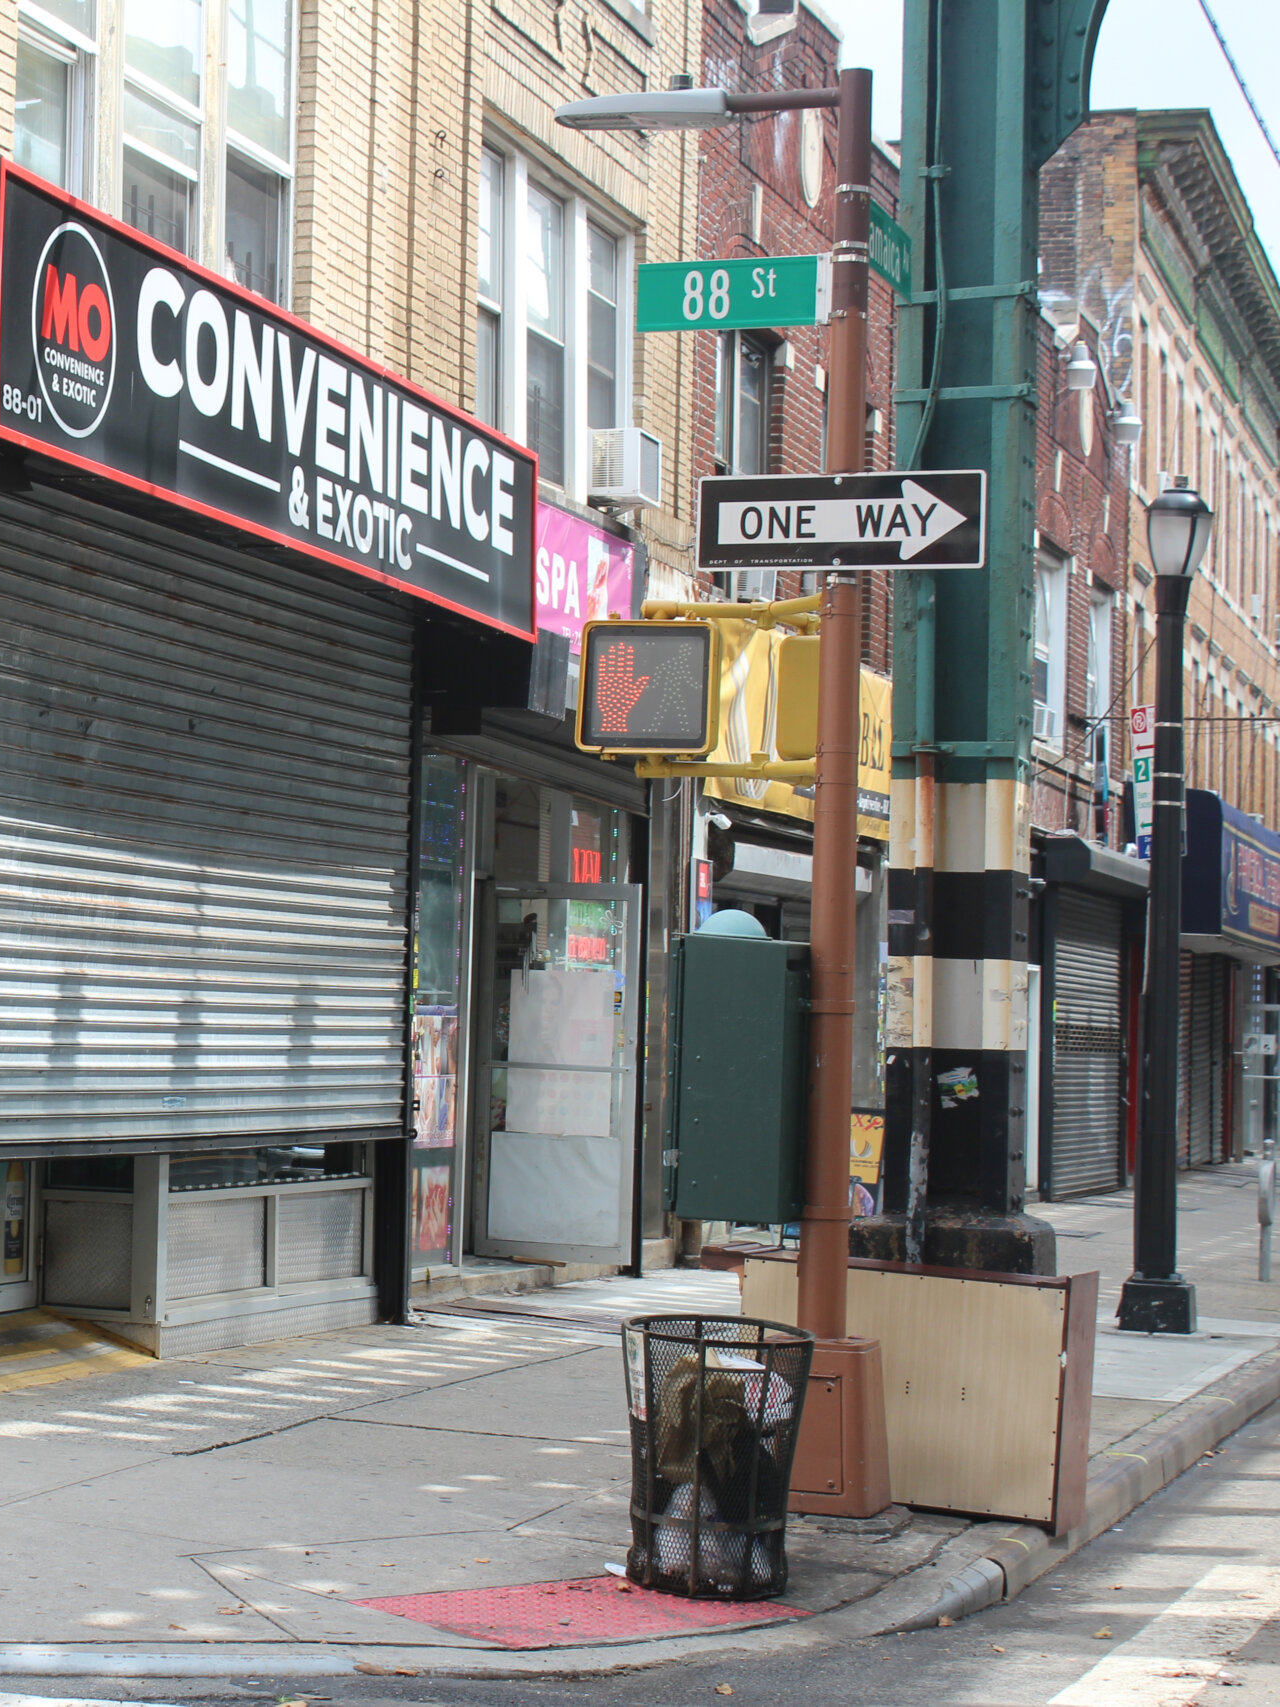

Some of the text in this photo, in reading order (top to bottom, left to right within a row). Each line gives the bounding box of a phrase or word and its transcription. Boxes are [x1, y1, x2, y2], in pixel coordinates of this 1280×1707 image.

[869, 221, 901, 283] amaica
[41, 263, 112, 362] MO
[682, 267, 777, 321] 88 St
[44, 347, 104, 386] CONVENIENCE
[52, 373, 97, 407] & EXOTIC
[2, 383, 42, 423] 88-01
[136, 266, 515, 556] CONVENIENCE
[288, 465, 413, 571] & EXOTIC
[739, 502, 938, 540] ONE WAY
[535, 546, 581, 619] SPA
[750, 557, 814, 565] TRANSPORTATION
[1137, 760, 1146, 781] 2
